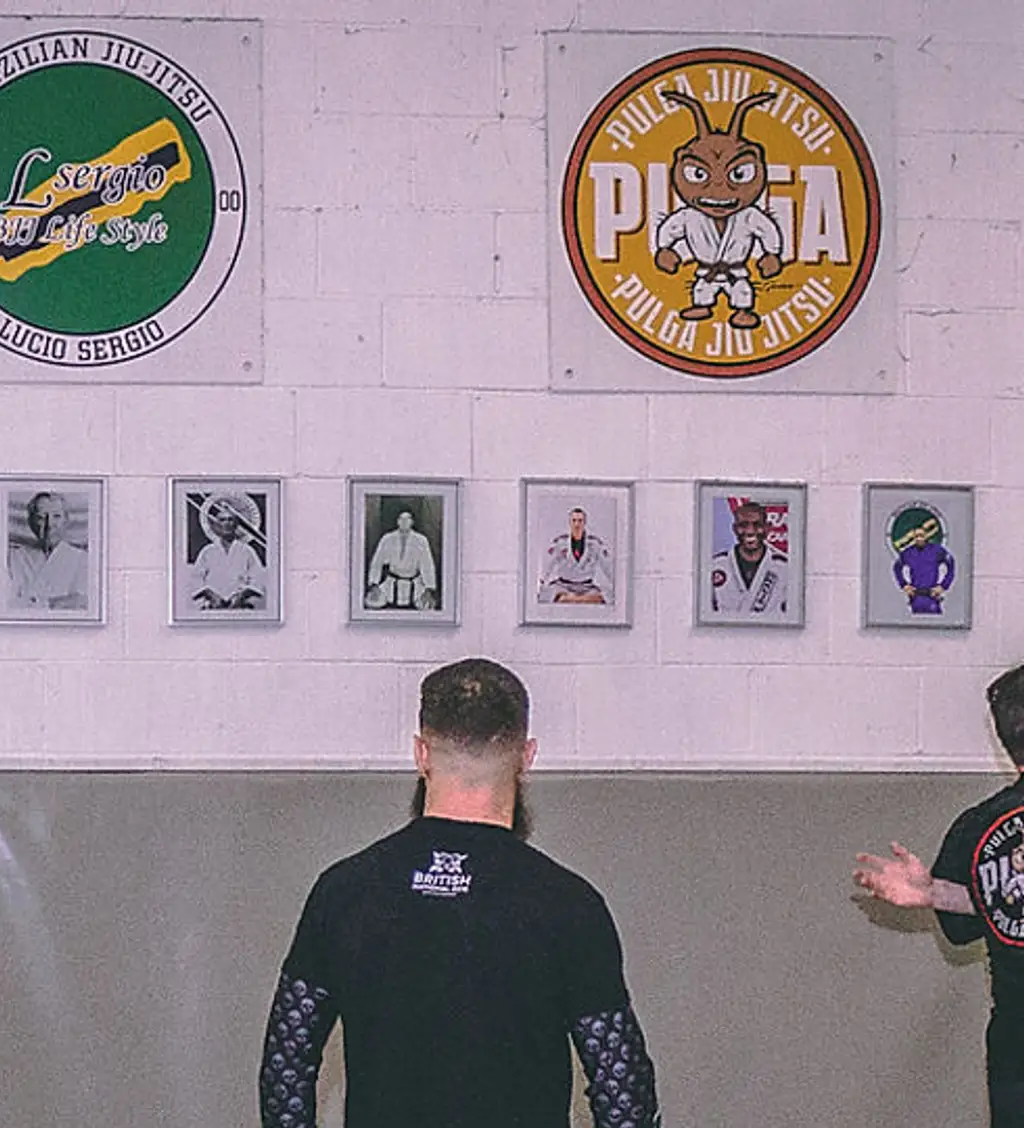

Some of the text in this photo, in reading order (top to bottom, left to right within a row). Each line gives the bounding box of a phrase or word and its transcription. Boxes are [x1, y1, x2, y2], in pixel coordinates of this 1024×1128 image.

[101, 41, 213, 124] JIU-JITSU
[606, 73, 696, 150] PULGA
[704, 68, 752, 104] JIU
[40, 213, 97, 251] Life
[99, 212, 168, 252] Style
[77, 319, 165, 361] SERGIO
[610, 273, 836, 357] PULGA JIU JITSU
[414, 871, 472, 885] BRITISH
